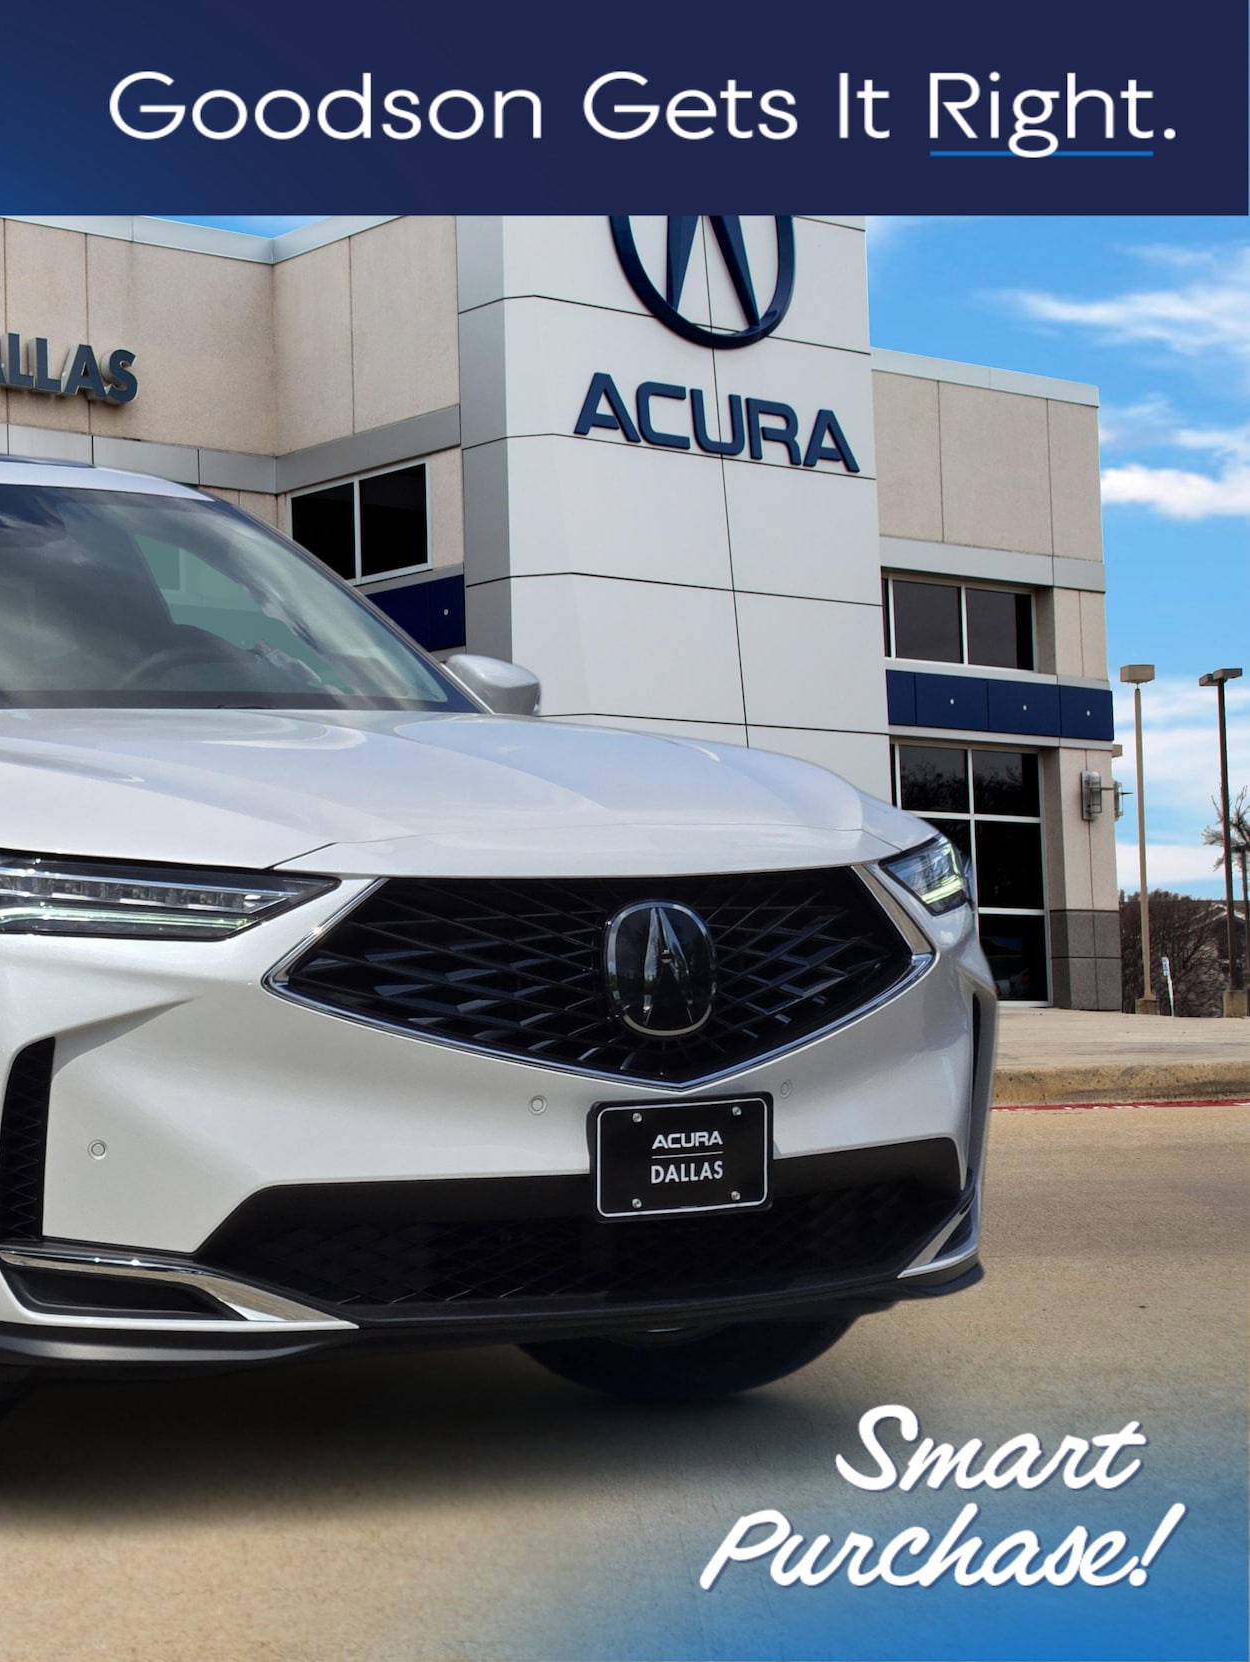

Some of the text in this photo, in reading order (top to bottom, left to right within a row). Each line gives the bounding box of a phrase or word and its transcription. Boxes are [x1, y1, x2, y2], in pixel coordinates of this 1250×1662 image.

[573, 372, 860, 473] ACURA
[651, 1130, 724, 1150] ACURA
[651, 1160, 724, 1184] DALLAS
